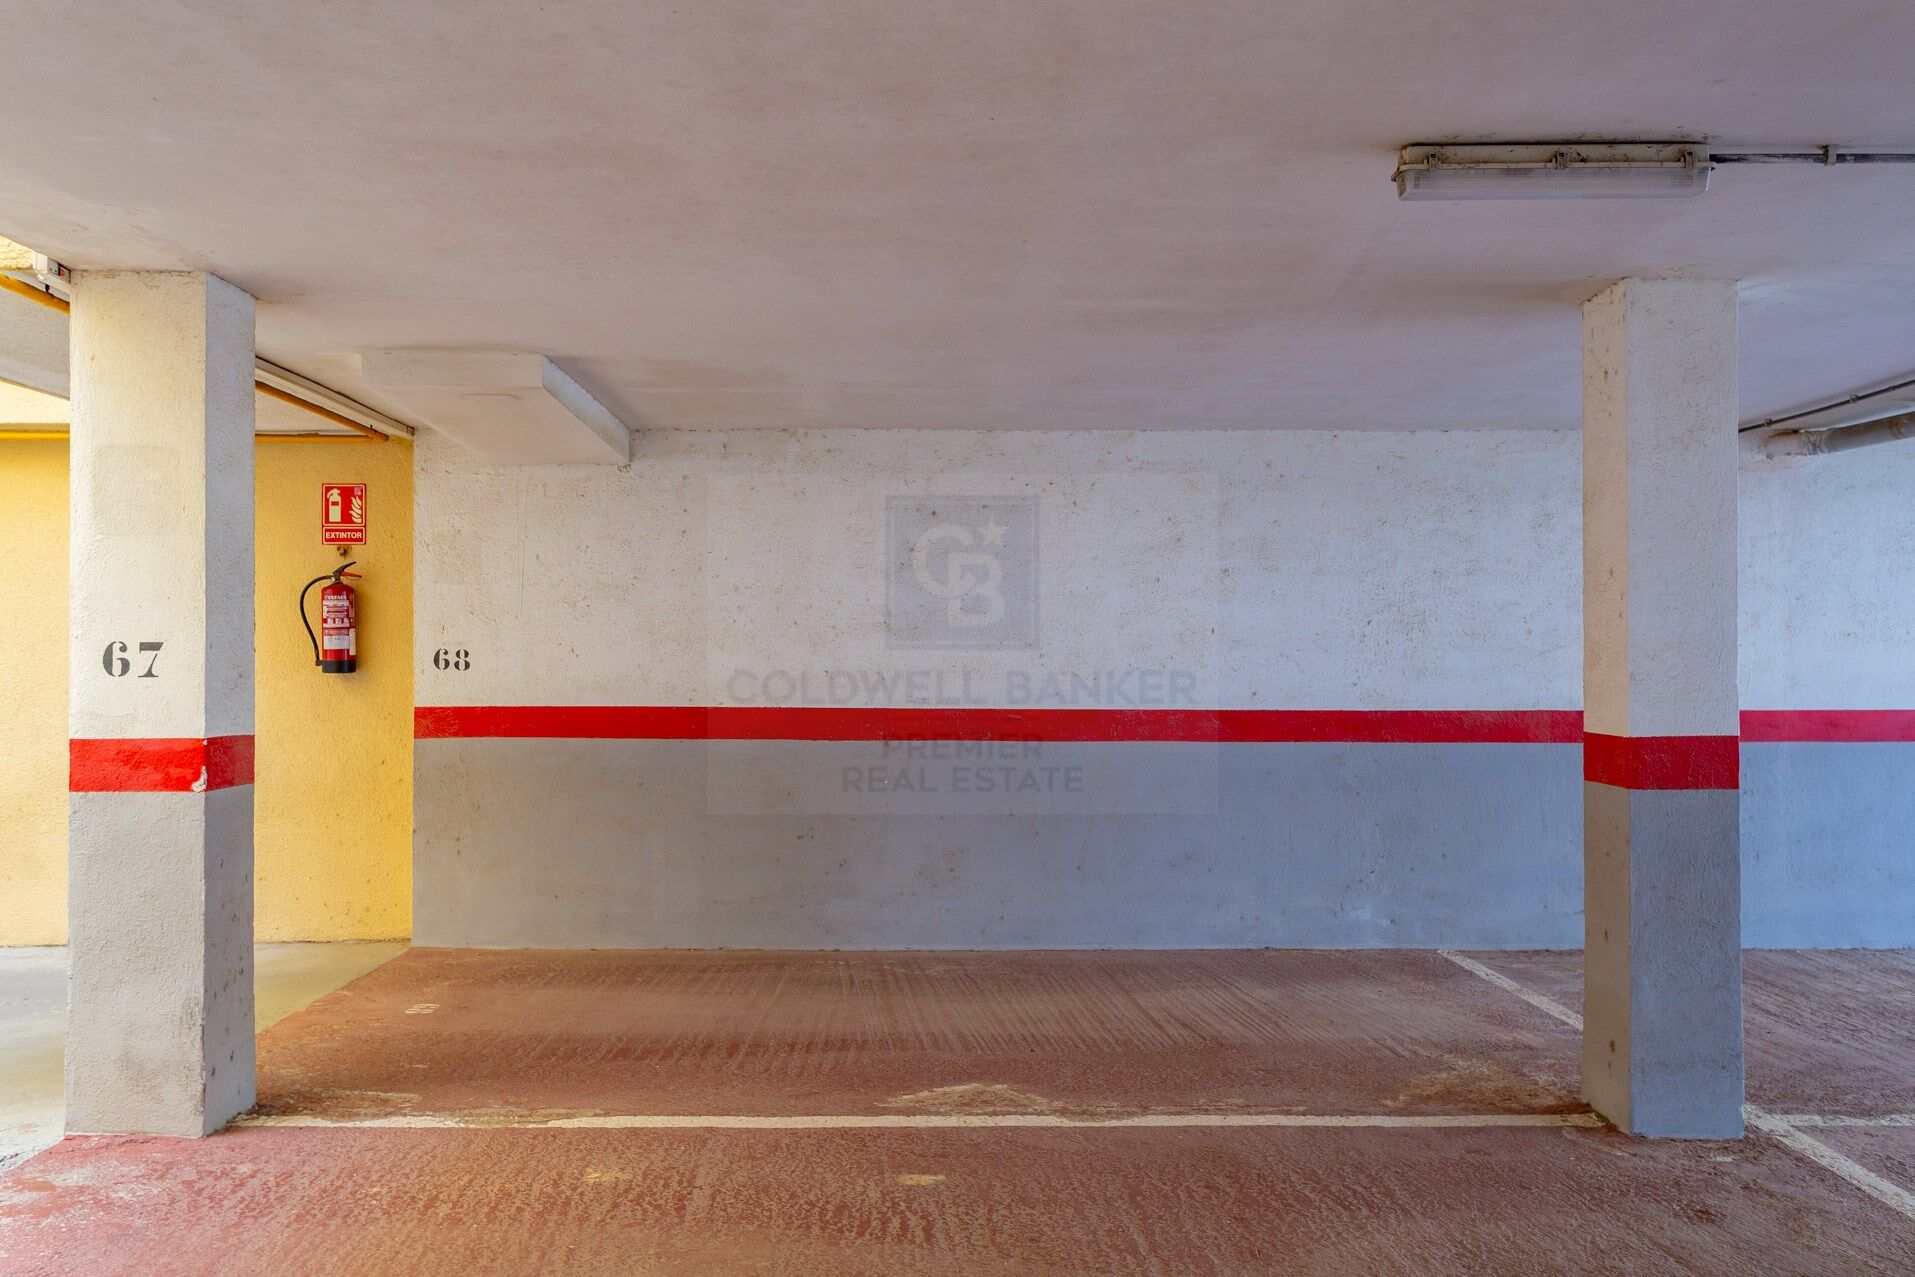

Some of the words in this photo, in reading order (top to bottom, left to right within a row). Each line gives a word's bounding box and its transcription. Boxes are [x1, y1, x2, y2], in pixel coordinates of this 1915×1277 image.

[325, 531, 362, 539] EXTINTOR
[102, 641, 164, 678] 67
[433, 648, 471, 671] 68
